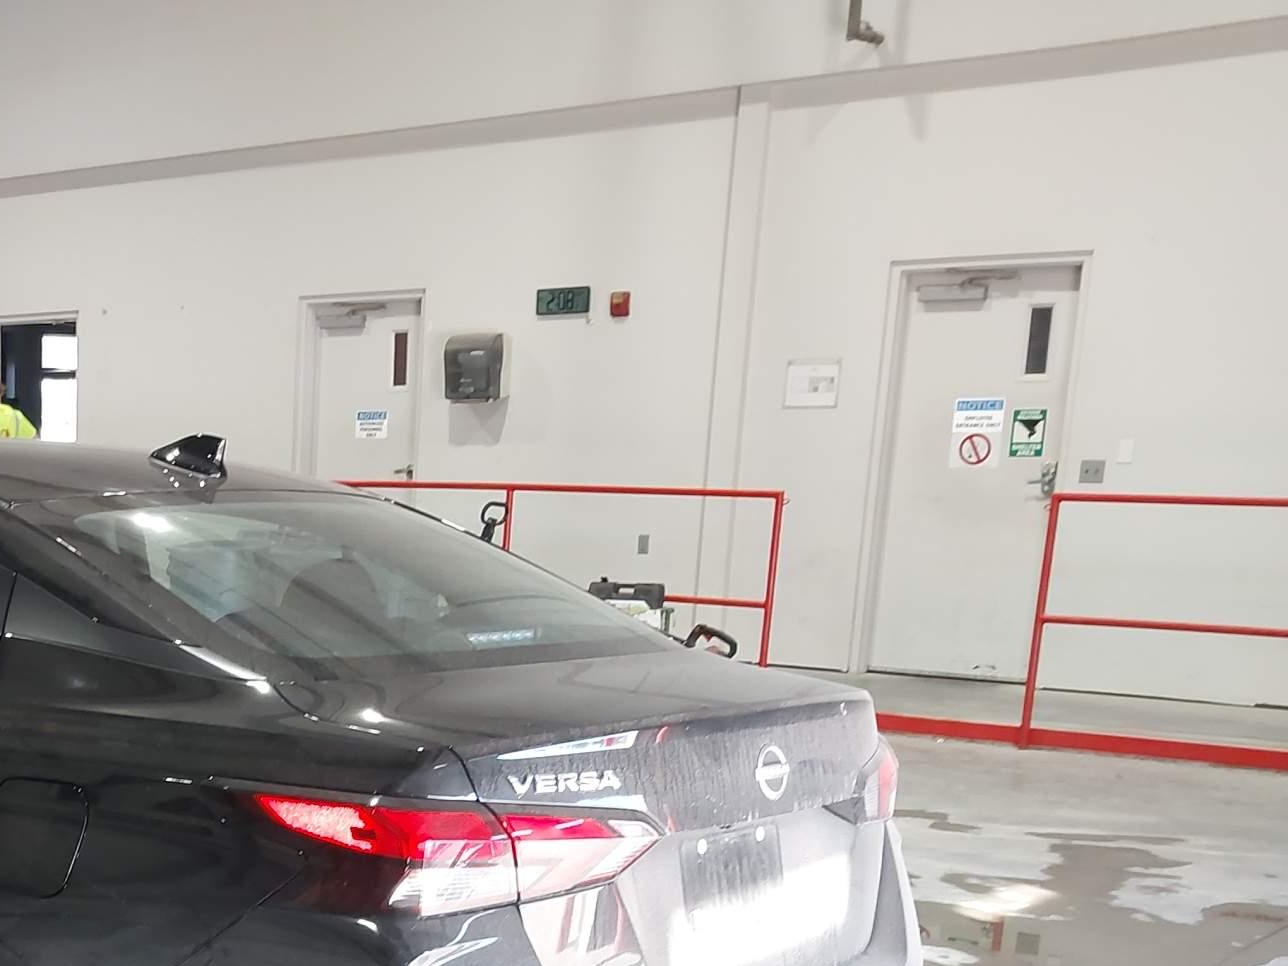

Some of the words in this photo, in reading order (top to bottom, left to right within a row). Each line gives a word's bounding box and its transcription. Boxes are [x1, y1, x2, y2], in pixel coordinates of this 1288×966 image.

[958, 400, 1001, 410] NOTICE
[359, 411, 386, 420] NOTICE
[508, 769, 622, 799] VERSA
